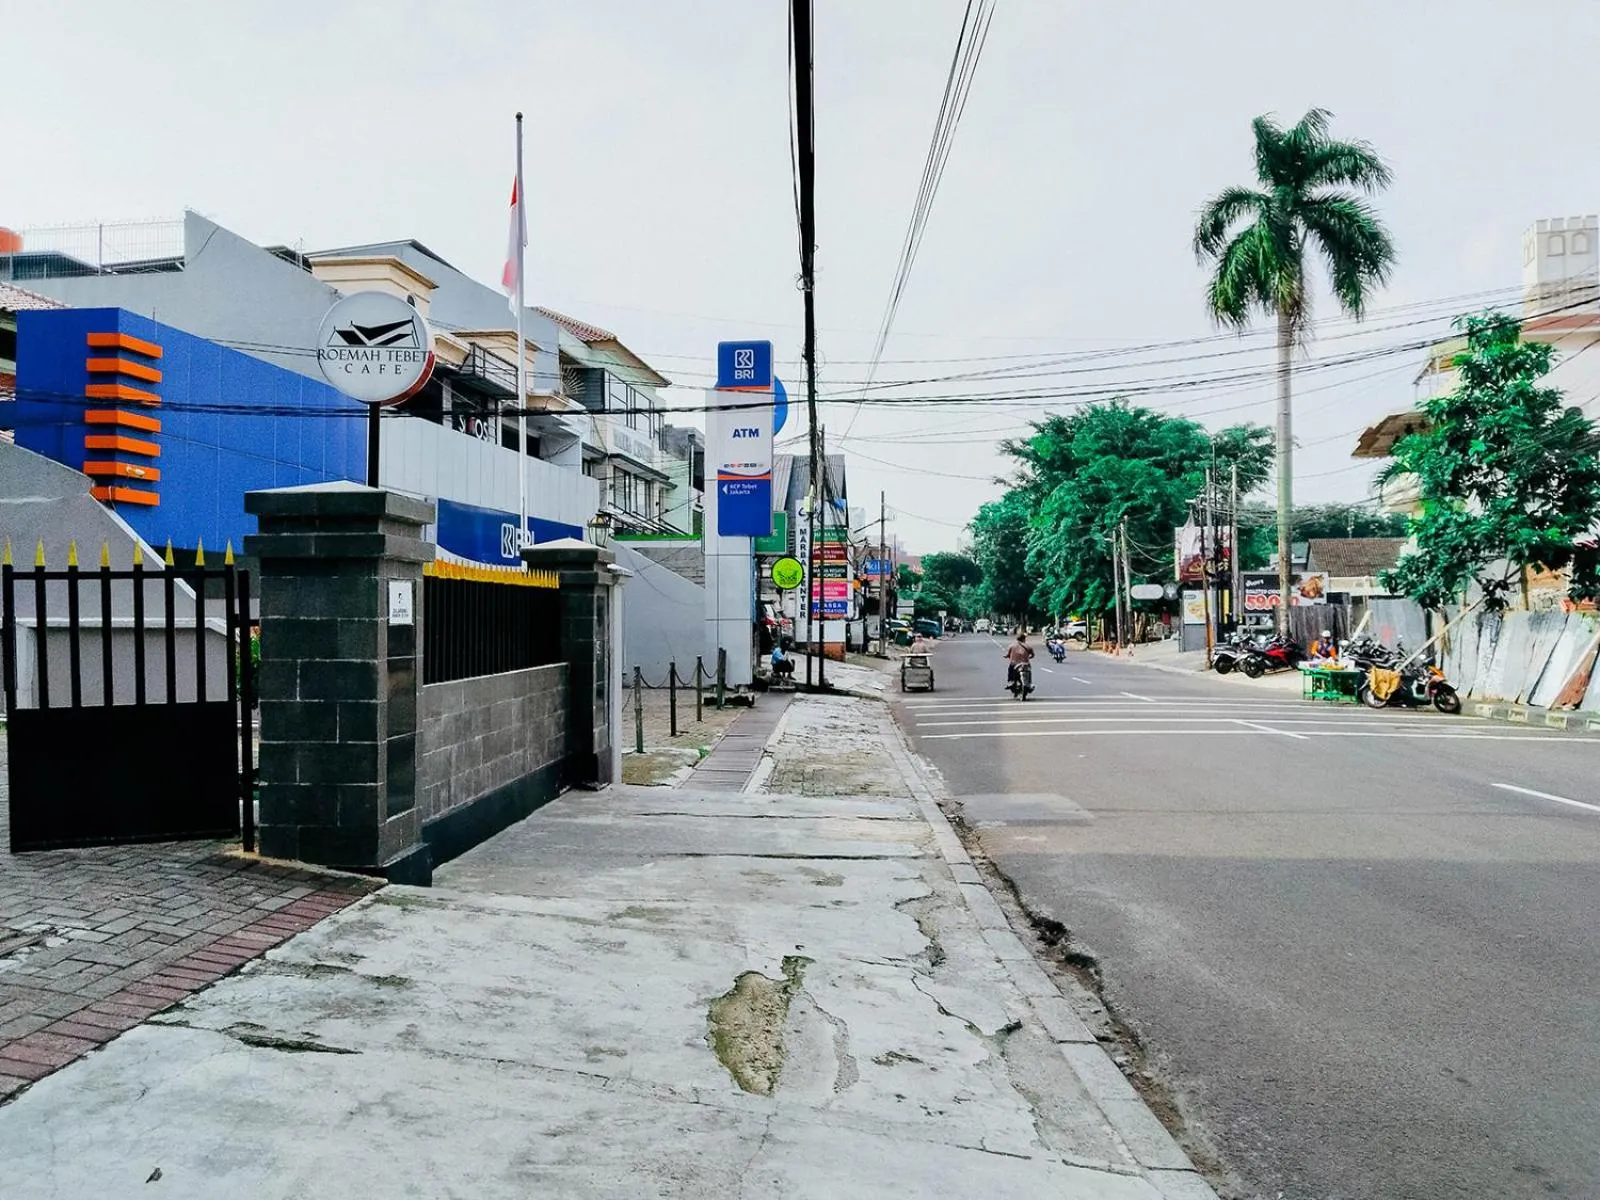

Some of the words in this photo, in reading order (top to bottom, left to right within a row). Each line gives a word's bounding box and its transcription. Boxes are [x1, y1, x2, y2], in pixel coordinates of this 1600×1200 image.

[318, 348, 380, 361] ROEMAH
[386, 350, 429, 362] TEBET
[735, 370, 754, 379] BRI
[732, 428, 759, 438] ATM
